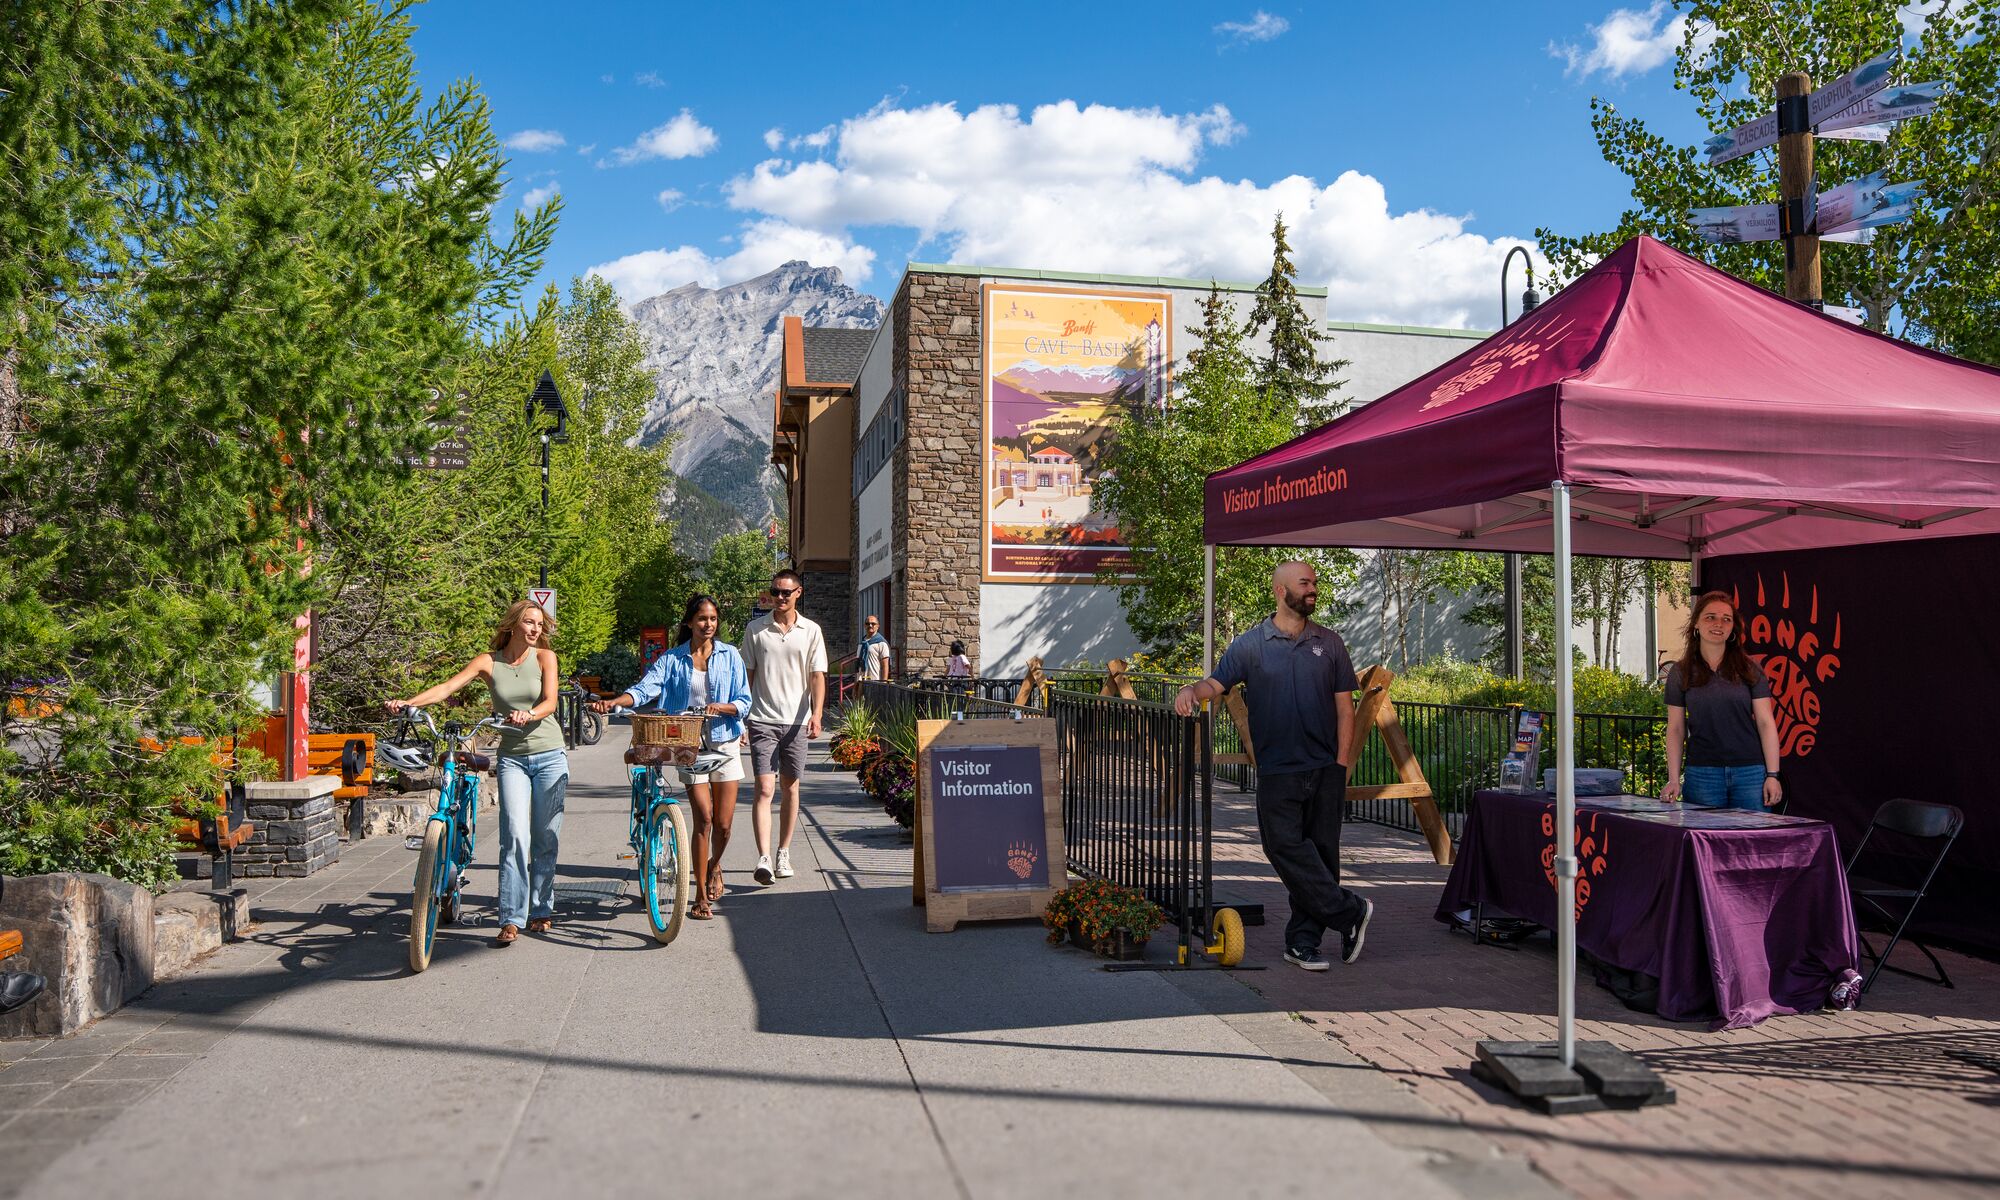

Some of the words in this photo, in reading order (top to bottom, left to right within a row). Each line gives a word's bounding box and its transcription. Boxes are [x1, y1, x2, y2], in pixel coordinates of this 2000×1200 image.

[1812, 80, 1852, 115] SULPHUR
[1738, 119, 1776, 146] CASCADE
[1061, 320, 1097, 337] Banff
[1024, 336, 1069, 355] CAVE
[1082, 339, 1134, 358] BASIN
[1223, 487, 1261, 514] Visitor
[1264, 465, 1347, 506] Information
[940, 760, 991, 776] Visitor
[942, 780, 1033, 797] Information
